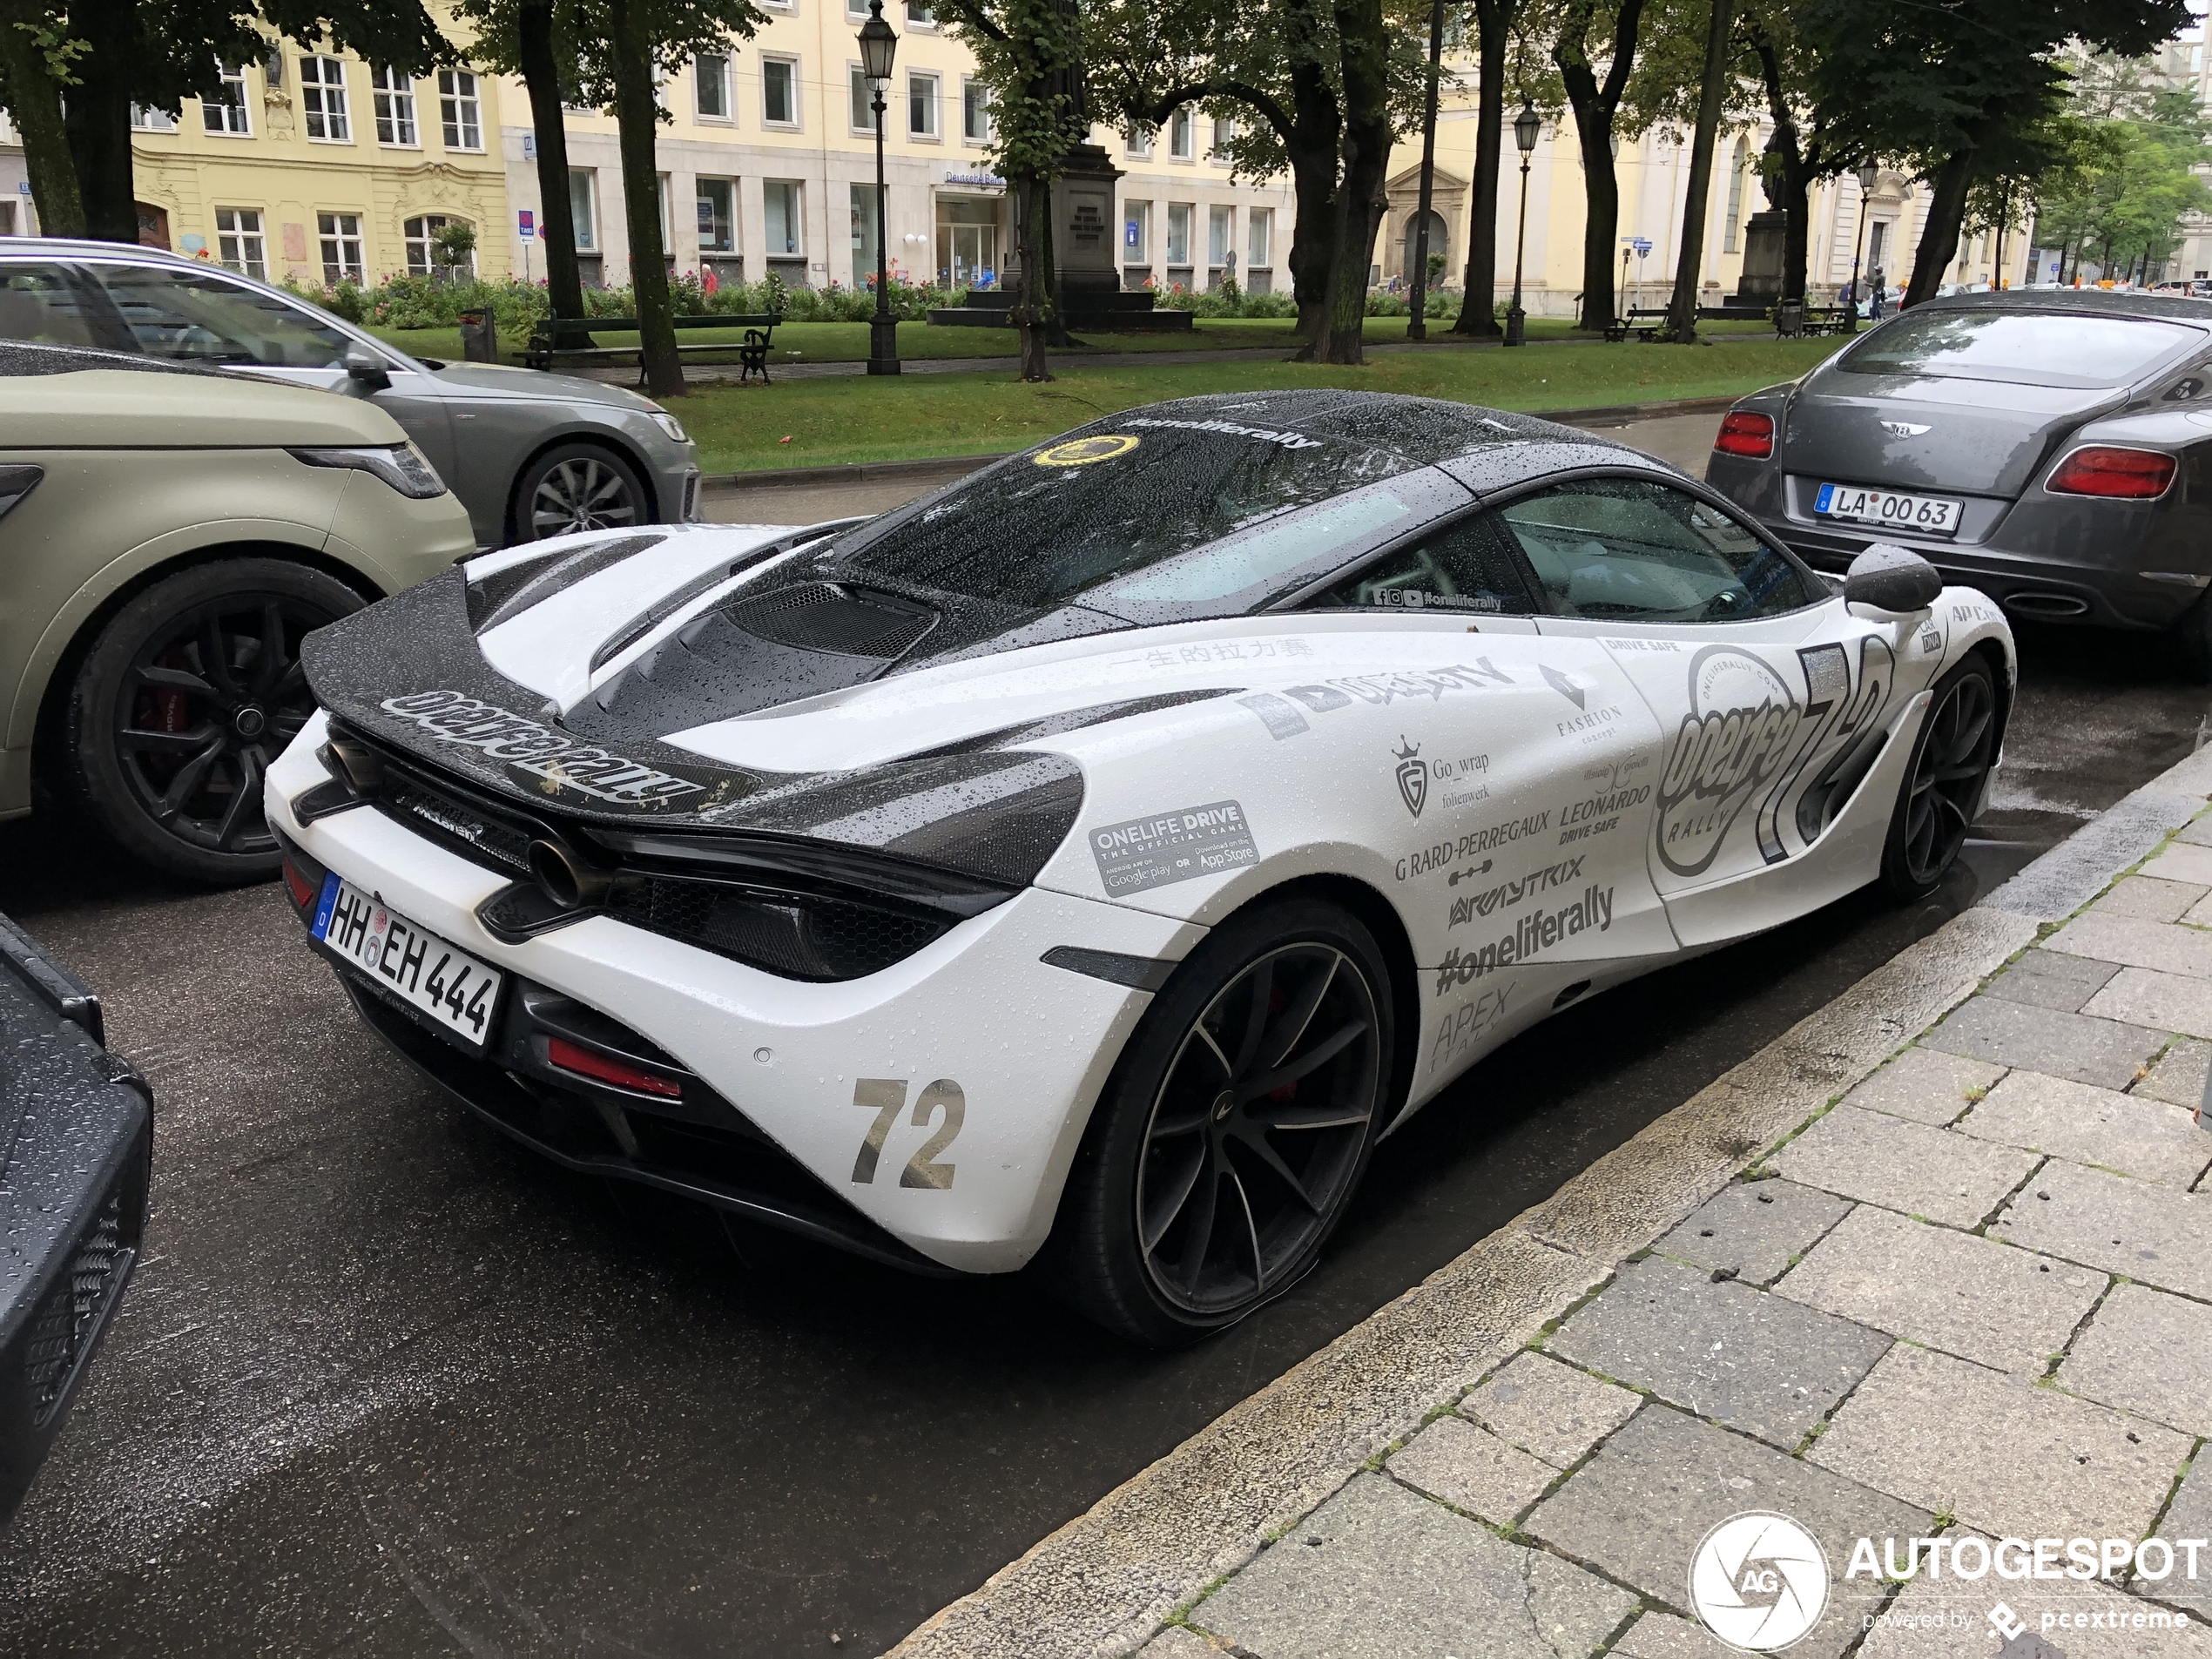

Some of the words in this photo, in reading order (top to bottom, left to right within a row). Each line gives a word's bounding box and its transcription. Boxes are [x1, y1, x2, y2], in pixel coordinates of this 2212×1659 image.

[946, 171, 983, 183] Deutsche
[984, 173, 1003, 185] Bank
[1836, 490, 1866, 515] LA
[1916, 502, 1950, 525] 63
[1424, 591, 1501, 610] #oneliferally
[1109, 638, 1314, 668] 一生的拉力赛
[1605, 639, 1648, 651] DRIVE
[1650, 641, 1682, 652] SAFE
[1924, 633, 1940, 651] DNA
[1703, 660, 1778, 700] ONELIFERALLY.COM
[166, 694, 178, 732] ROVER
[1556, 705, 1622, 737] FASHION
[1581, 727, 1617, 745] concept
[1433, 752, 1490, 782] Go_wrap
[1441, 785, 1490, 809] folienwerk
[1559, 785, 1651, 827] LEONARDO
[1097, 817, 1181, 850] ONELIFE
[1182, 806, 1240, 831] DRIVE
[1101, 848, 1130, 860] THE
[1137, 833, 1203, 854] OFFICIAL
[1211, 823, 1244, 836] GAME
[1558, 824, 1590, 846] DRIVE
[1592, 816, 1620, 837] SAFE
[1668, 809, 1730, 844] RALLY
[1194, 841, 1228, 856] Download
[1238, 837, 1250, 846] the
[1199, 853, 1224, 869] App
[1224, 846, 1254, 865] Store
[1106, 864, 1132, 874] ANDROID
[1108, 868, 1149, 888] Google
[1150, 865, 1171, 882] play
[1176, 858, 1191, 868] OR
[1448, 854, 1587, 932] ARMYTRIX
[318, 911, 326, 927] D
[1436, 884, 1615, 997] #oneliferally
[328, 887, 372, 956] HH
[379, 920, 428, 993] EH
[425, 953, 493, 1035] 444
[386, 995, 421, 1026] HAMBURG
[1431, 980, 1517, 1058] APEX
[1427, 1017, 1502, 1074] ITALY
[851, 1077, 966, 1190] 72
